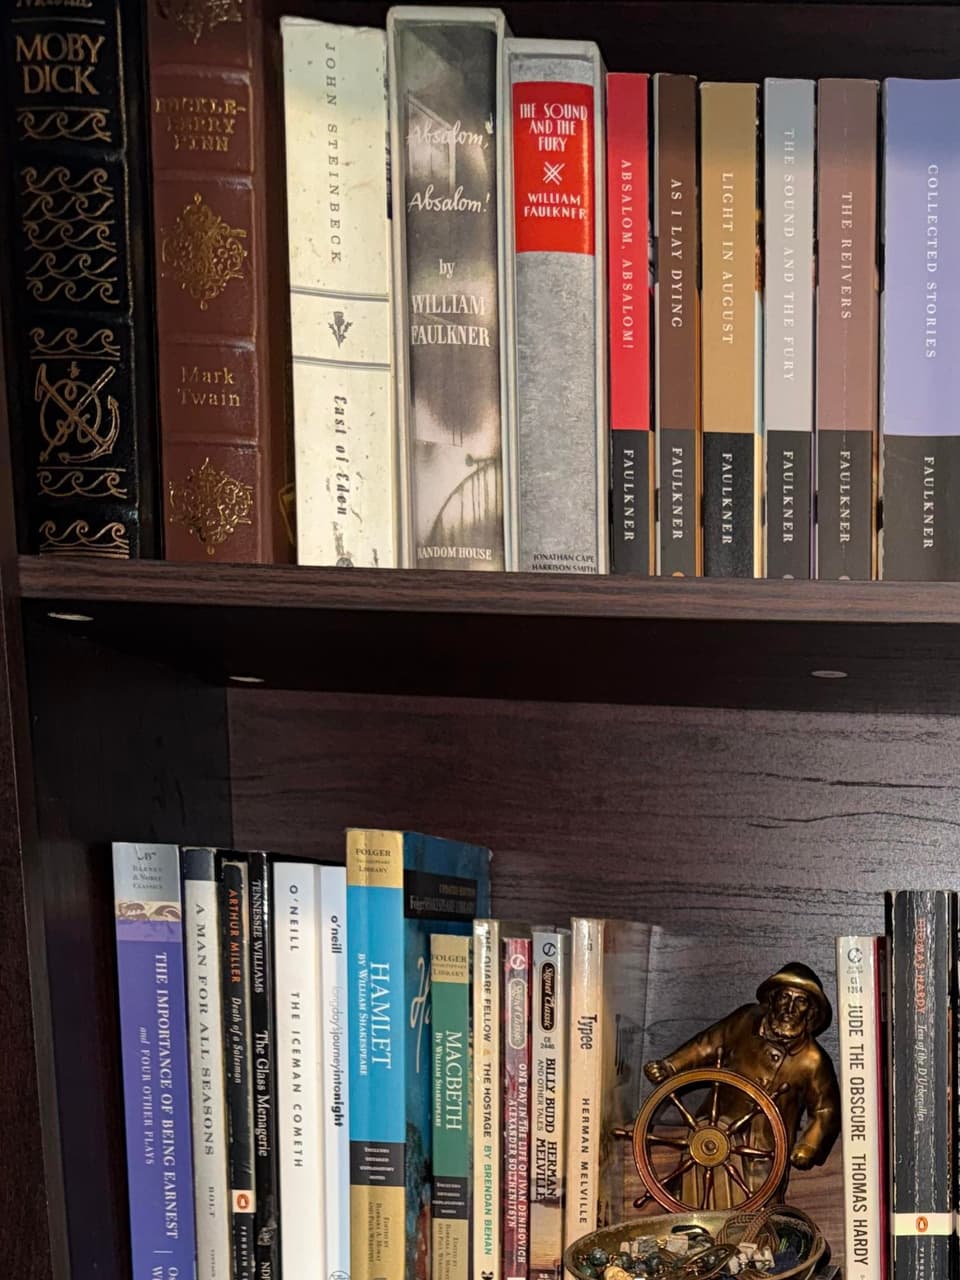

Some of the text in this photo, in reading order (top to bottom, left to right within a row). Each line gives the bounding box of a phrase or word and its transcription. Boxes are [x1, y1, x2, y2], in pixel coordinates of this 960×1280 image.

[16, 33, 106, 63] MOBY
[24, 65, 99, 95] DICK
[520, 103, 588, 120] THE SOUND
[528, 120, 576, 135] AND THE
[325, 43, 341, 263] JOHN STEINBECK
[539, 137, 567, 152] FURY
[408, 185, 490, 213] Absalom!
[671, 179, 682, 200] AS
[671, 226, 682, 260] LAY
[722, 172, 733, 344] LIGHT IN AUGUST
[926, 164, 939, 359] COLLECTED STORIES
[412, 294, 485, 316] WILLIAM
[671, 270, 683, 328] DYING
[411, 326, 490, 347] FAULKNER
[229, 889, 240, 983] ARTHUR MILLER
[252, 880, 264, 993] TENNESSEE WILLIAMS
[289, 885, 299, 952] O'NEILL
[370, 962, 392, 1069] HAMLET
[580, 1014, 598, 1050] Typee
[446, 1031, 463, 1131] MACBETH
[579, 1098, 590, 1223] HERMAN MELVILLE
[848, 1002, 869, 1266] JUDE THE OBSCURE THOMAS HARDY
[161, 1119, 178, 1239] BEING EARNEST
[483, 1164, 493, 1255] BRENDAN BEHAN
